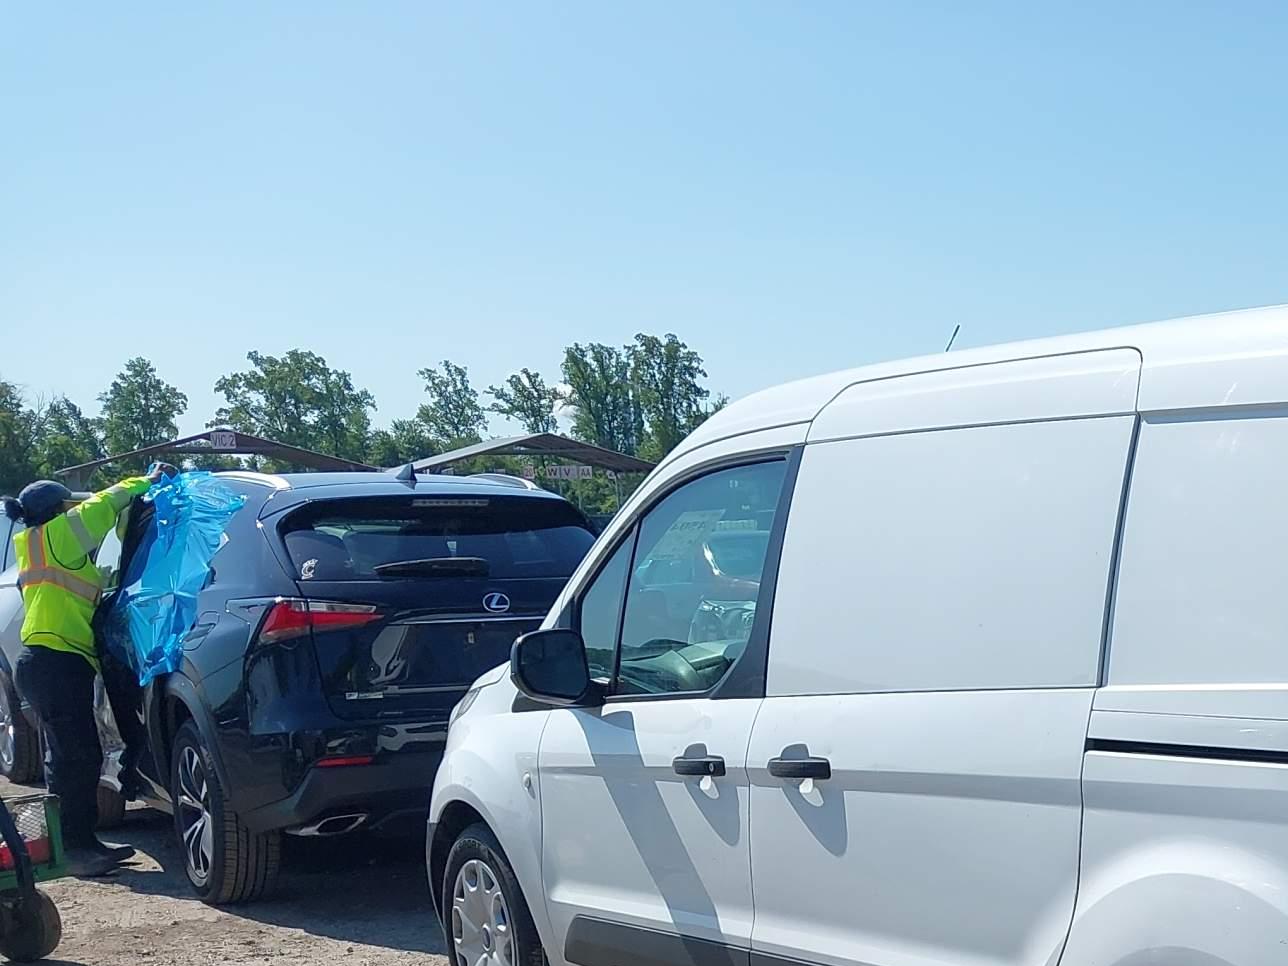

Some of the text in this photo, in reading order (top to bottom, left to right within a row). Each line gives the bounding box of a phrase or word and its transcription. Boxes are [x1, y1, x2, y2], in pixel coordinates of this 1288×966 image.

[229, 434, 235, 447] 2
[547, 465, 558, 477] W
[564, 465, 571, 477] V
